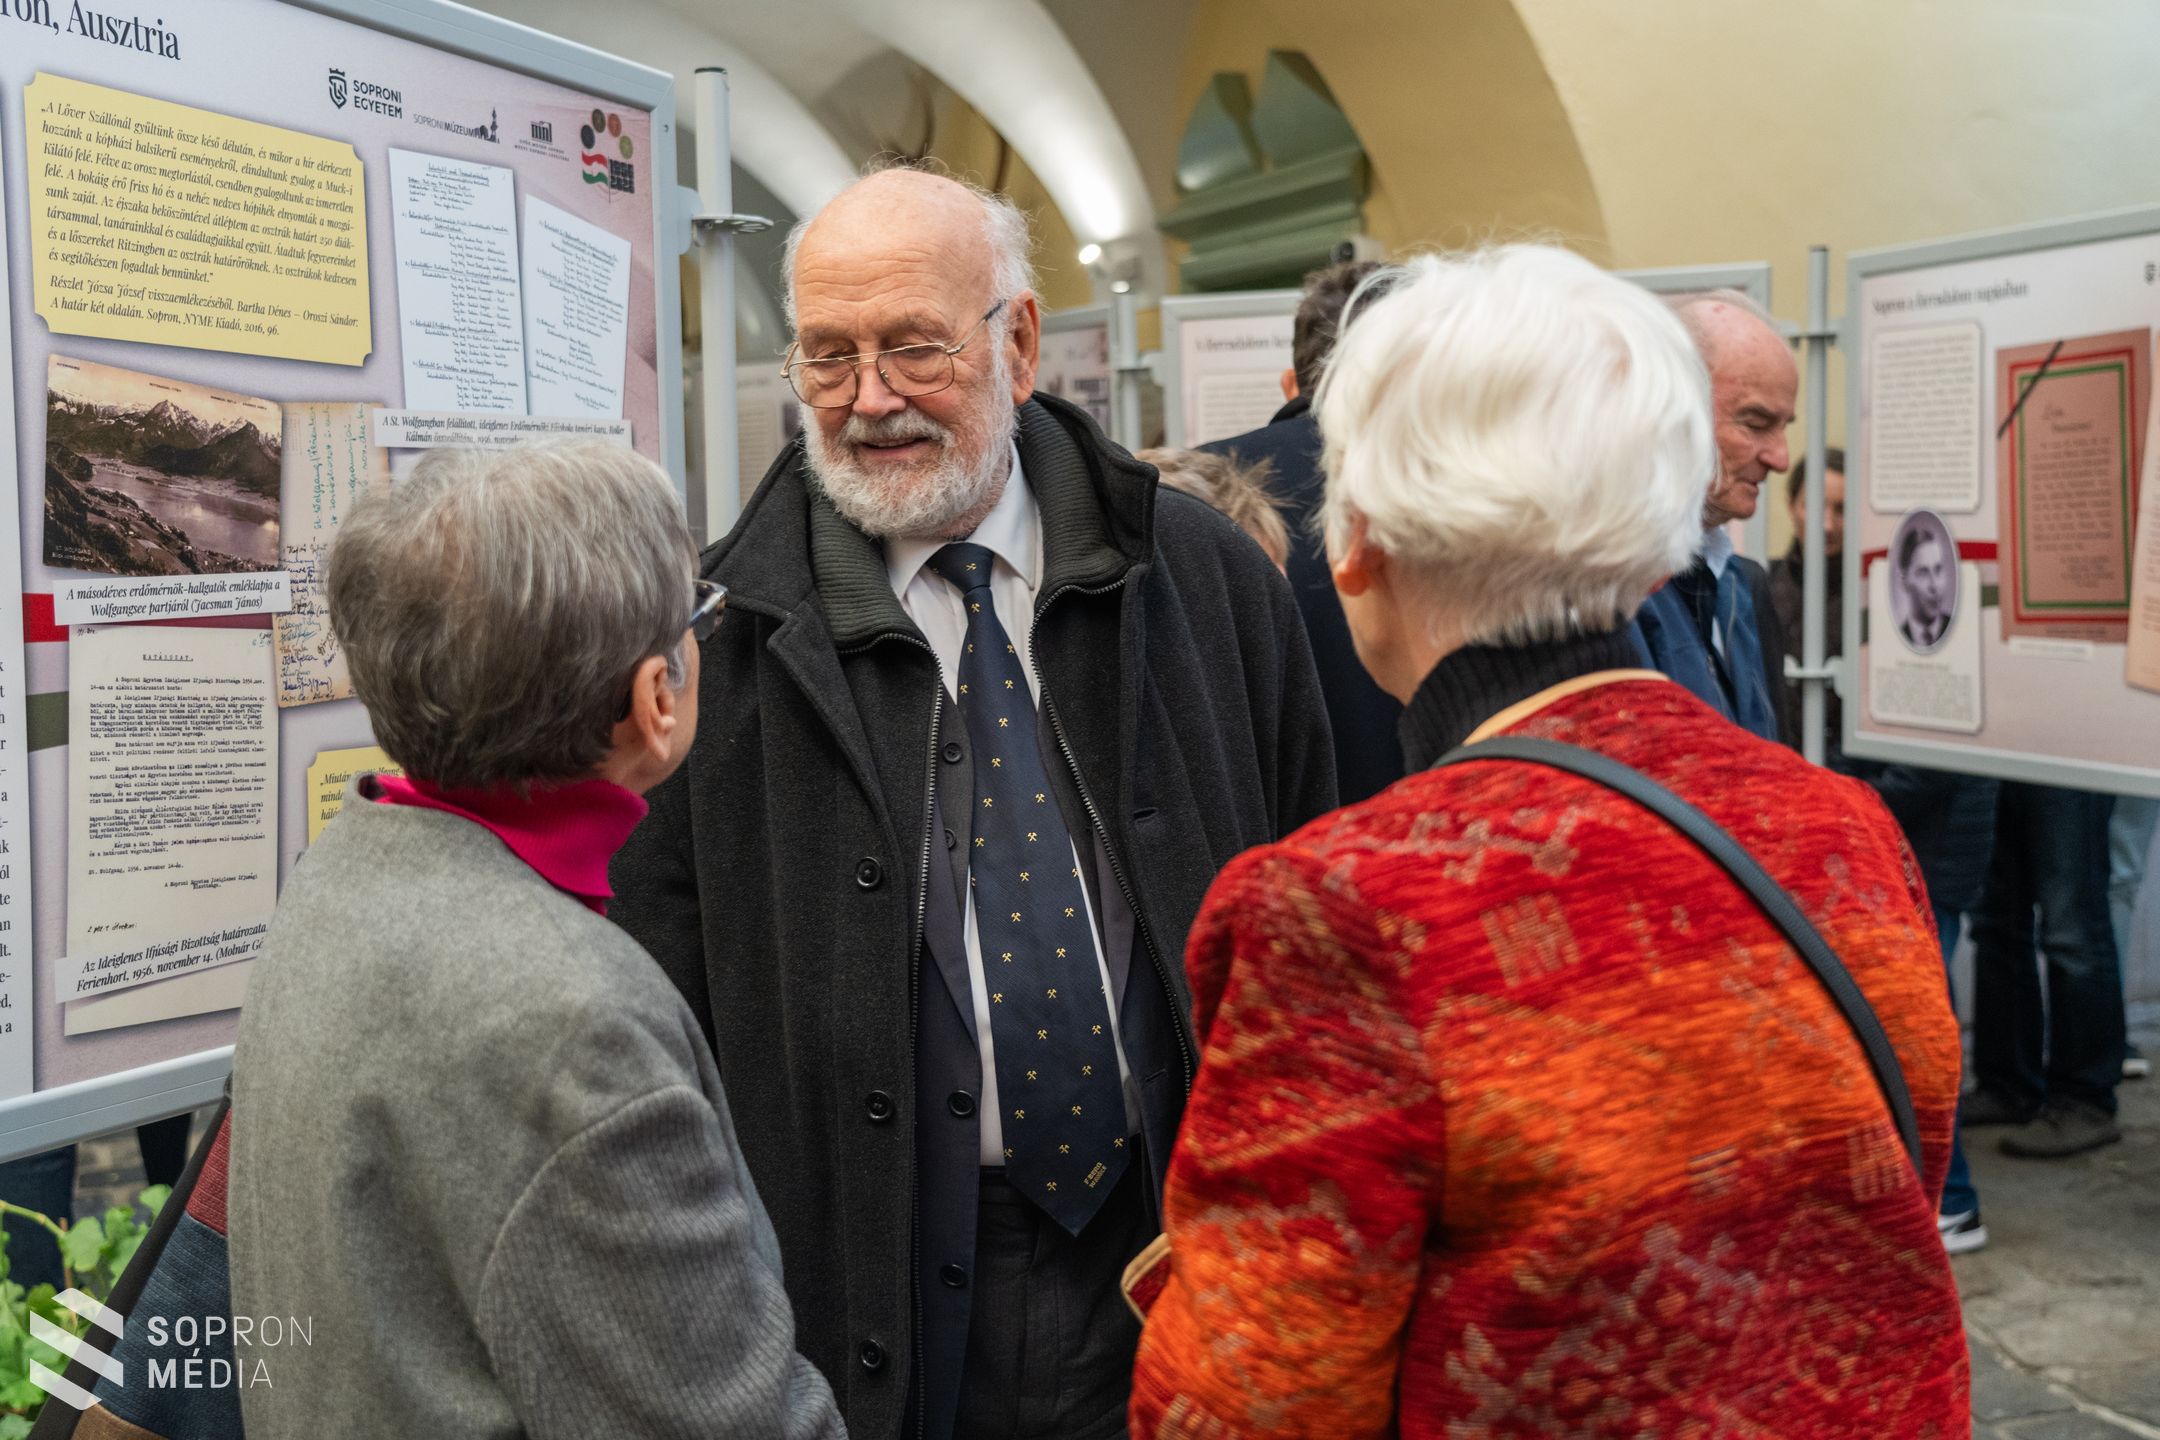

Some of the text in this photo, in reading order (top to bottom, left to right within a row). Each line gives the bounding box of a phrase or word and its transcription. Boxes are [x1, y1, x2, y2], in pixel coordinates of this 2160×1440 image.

[67, 0, 181, 60] Ausztria
[353, 80, 402, 104] SOPRONI
[354, 95, 403, 120] EGYETEM
[42, 120, 83, 140] hozzánk
[86, 133, 92, 142] a
[96, 131, 132, 150] kópházi
[135, 139, 177, 160] balsikerű
[241, 162, 288, 182] elindultunk
[289, 175, 315, 190] gyalog
[317, 181, 322, 189] a
[57, 103, 86, 119] Lőver
[88, 110, 131, 130] Szállónál
[133, 121, 174, 139] gyűltünk
[177, 129, 198, 144] össze
[201, 134, 220, 149] késő
[258, 146, 267, 159] és
[269, 151, 293, 164] mikor
[295, 158, 300, 166] a
[303, 156, 315, 168] hír
[316, 160, 351, 177] elérkezett
[44, 142, 73, 159] Kilátó
[95, 152, 120, 168] Félve
[121, 161, 132, 170] az
[134, 163, 157, 176] orosz
[215, 179, 252, 194] csendben
[253, 186, 304, 204] gyalogoltunk
[305, 197, 314, 206] az
[316, 196, 353, 214] ismeretlen
[66, 168, 74, 180] A
[78, 169, 109, 189] bokáig
[111, 176, 127, 190] érő
[129, 179, 149, 194] friss
[152, 183, 163, 196] hó
[166, 185, 175, 199] és
[177, 192, 183, 200] a
[186, 191, 210, 207] nehéz
[213, 196, 241, 211] nedves
[243, 200, 275, 217] hópihék
[277, 208, 317, 225] elnyomták
[319, 218, 324, 226] a
[45, 187, 69, 200] sunk
[101, 195, 114, 208] Az
[116, 196, 149, 214] éjszaka
[152, 202, 211, 224] beköszöntével
[212, 214, 248, 231] átléptem
[250, 224, 260, 233] az
[262, 226, 291, 239] osztrák
[293, 228, 317, 243] határt
[335, 236, 354, 249] diák-
[104, 216, 164, 236] tanárainkkal
[165, 225, 174, 238] és
[175, 229, 244, 250] családtagjaikkal
[274, 242, 306, 260] Átadtuk
[307, 249, 356, 268] fegyvereinket
[48, 226, 58, 240] és
[60, 232, 66, 241] a
[69, 229, 115, 248] lőszereket
[117, 238, 165, 256] Ritzingben
[167, 249, 178, 258] az
[180, 250, 212, 264] osztrák
[272, 264, 283, 275] Az
[285, 267, 322, 280] osztrákok
[324, 270, 356, 286] kedvesen
[49, 247, 59, 261] és
[60, 251, 118, 270] segítőkészen
[120, 258, 160, 276] fogadtak
[50, 275, 84, 291] Részlet
[87, 280, 114, 295] Józsa
[117, 284, 147, 301] József
[237, 301, 265, 315] Bartha
[268, 305, 291, 318] Dénes
[303, 310, 328, 323] Oroszi
[50, 297, 58, 308] A
[61, 296, 89, 311] határ
[90, 300, 104, 314] két
[401, 416, 445, 430] Wolfgangban
[405, 430, 432, 442] Kálmán
[66, 579, 280, 600] A másodéves erdőmérnök-hallgatók emléklapja a
[91, 595, 263, 616] Wolfgangsee partjáról (Jacsman János)
[77, 970, 129, 992] Ferienhort,
[133, 964, 154, 980] 1956.
[157, 954, 201, 973] november
[203, 953, 213, 963] 14.
[216, 941, 250, 961] (Molnár
[82, 962, 95, 974] Az
[98, 952, 143, 970] Ideiglenes
[145, 940, 179, 960] Ifjúsági
[180, 932, 220, 951] Bizottság
